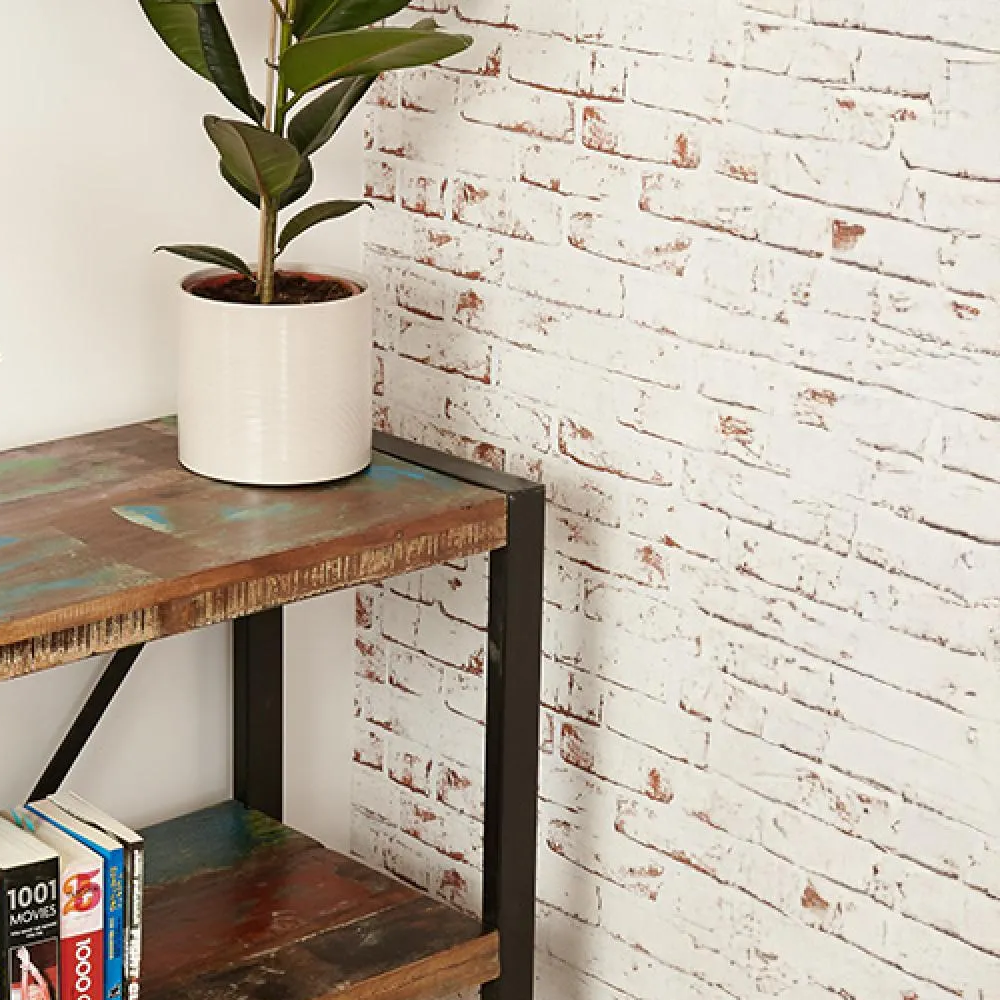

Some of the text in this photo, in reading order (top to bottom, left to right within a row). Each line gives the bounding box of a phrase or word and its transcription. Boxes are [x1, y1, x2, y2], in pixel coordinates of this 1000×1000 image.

[6, 879, 57, 911] 1001
[9, 903, 57, 927] MOVIES
[75, 937, 92, 992] 1000
